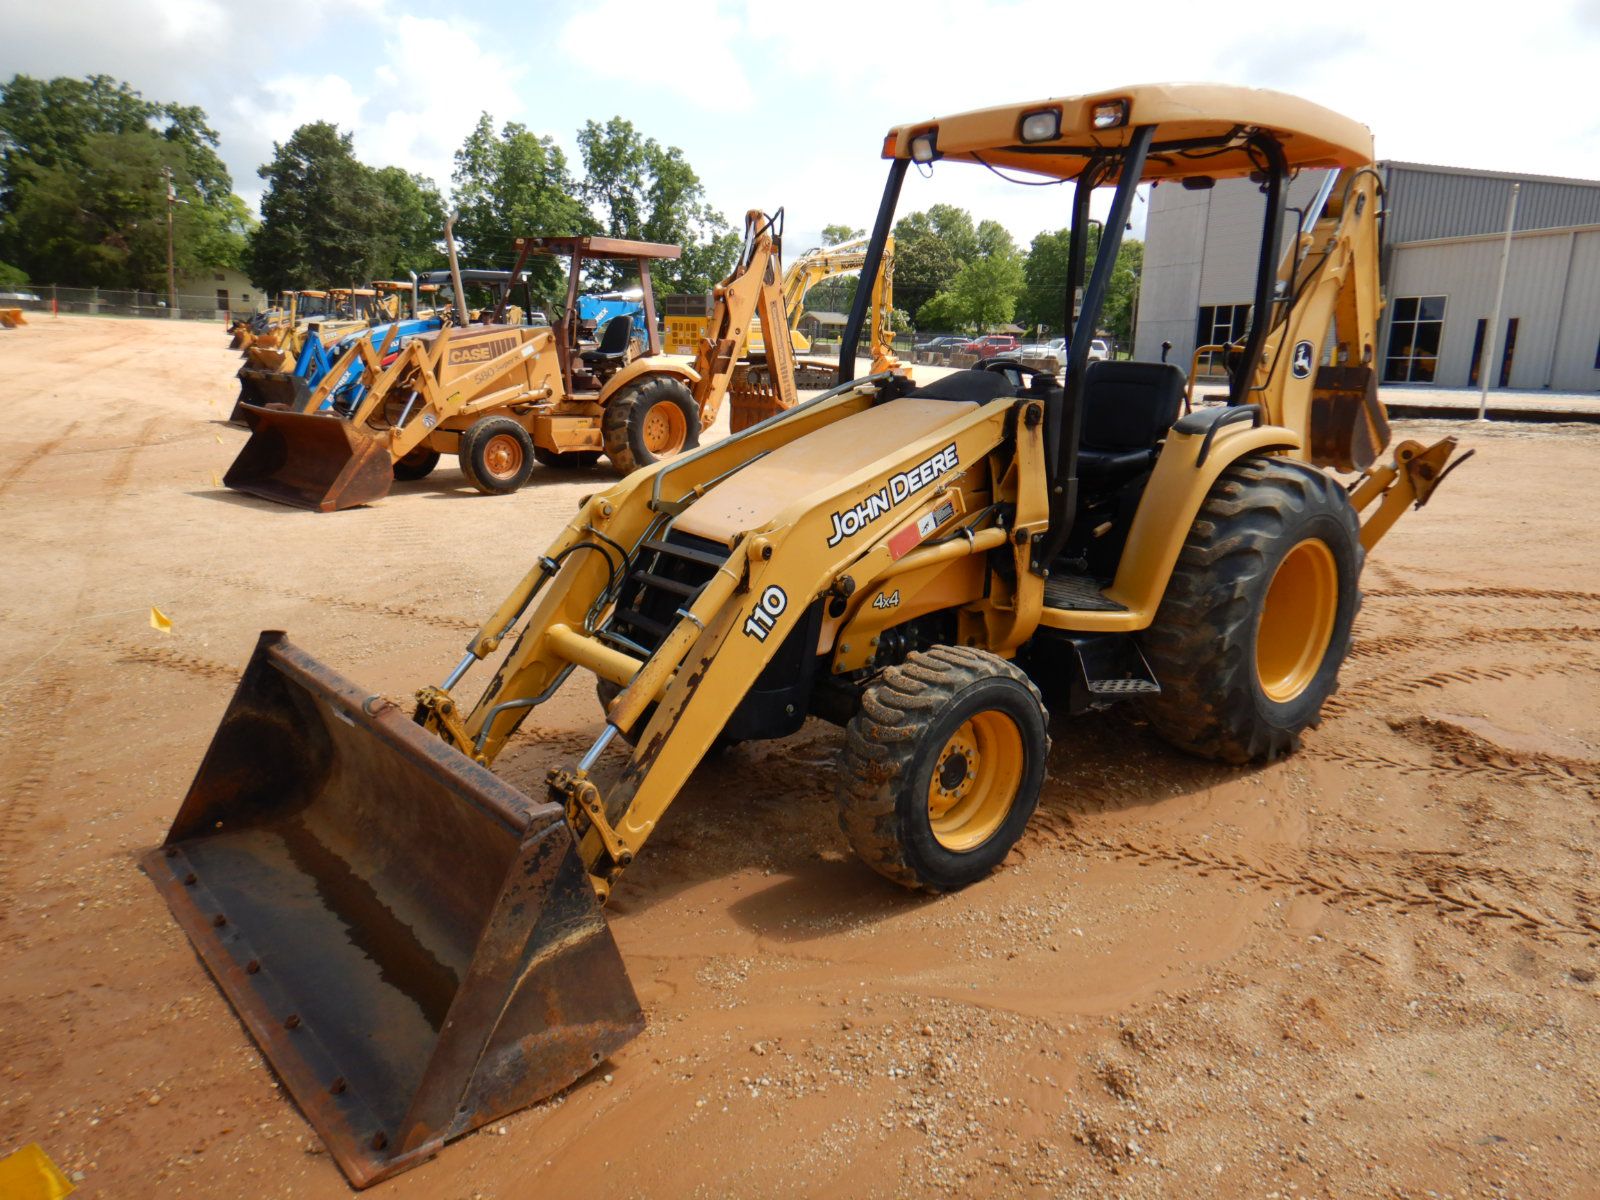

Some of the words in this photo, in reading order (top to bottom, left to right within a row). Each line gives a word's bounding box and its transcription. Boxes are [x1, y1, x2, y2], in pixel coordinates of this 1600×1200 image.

[451, 348, 490, 362] CASE
[474, 367, 495, 384] 580
[827, 486, 891, 548] JOHN
[888, 441, 959, 507] DEERE
[872, 589, 900, 609] 4x4
[742, 584, 788, 643] 110
